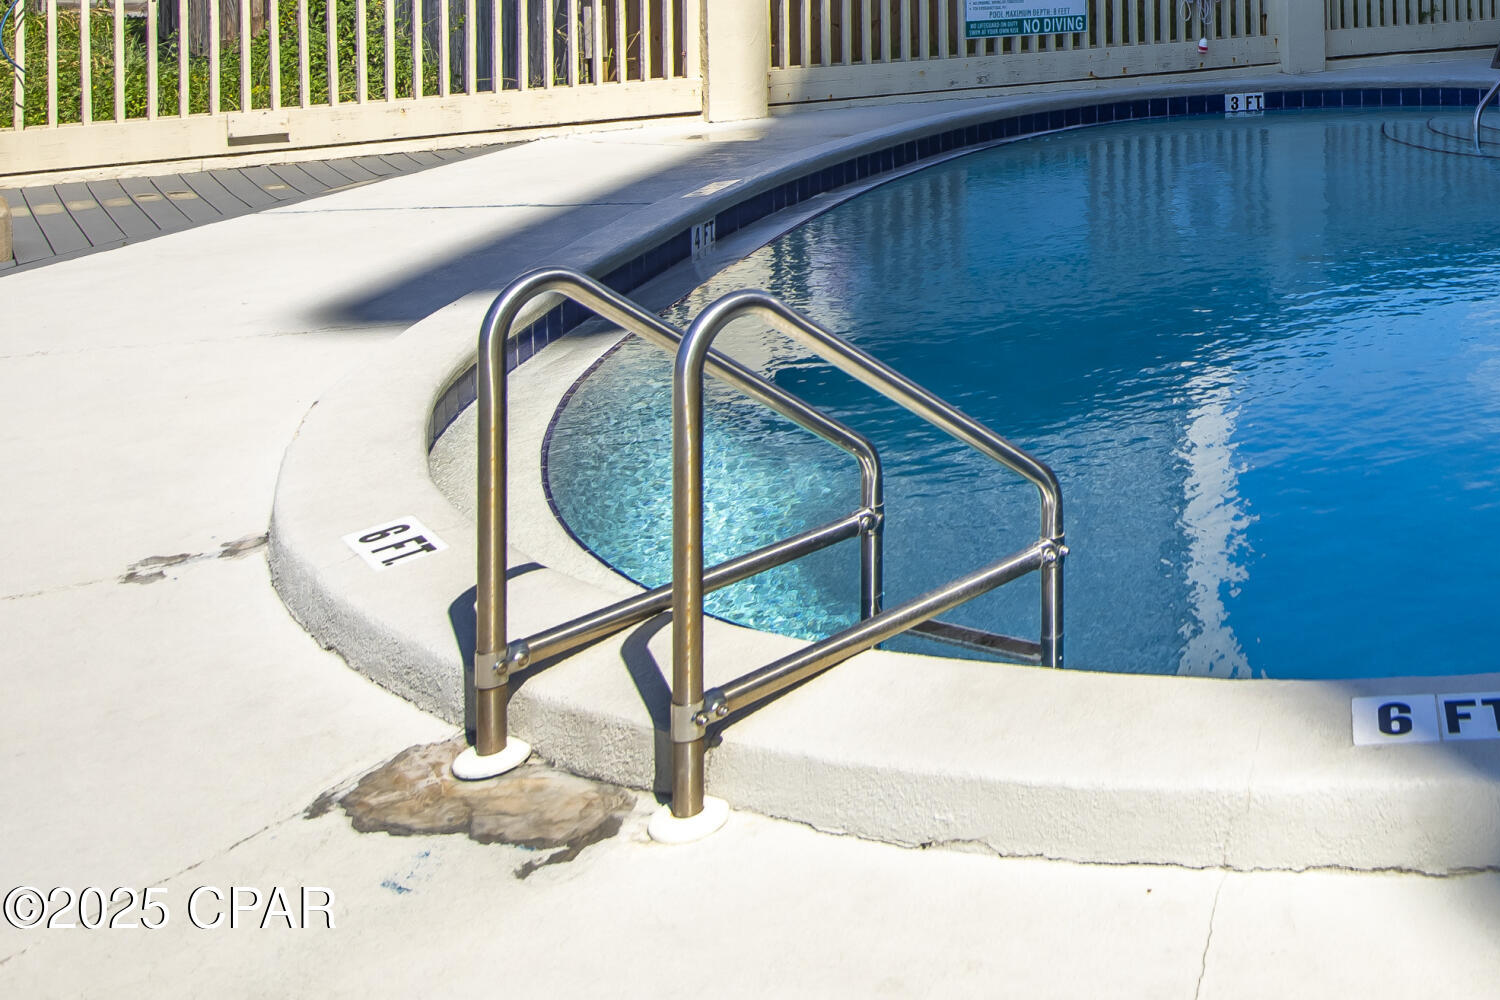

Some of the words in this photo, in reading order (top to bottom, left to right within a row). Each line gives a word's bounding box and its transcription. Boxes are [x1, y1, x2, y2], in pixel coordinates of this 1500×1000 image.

[989, 10, 1004, 18] POOL
[1005, 9, 1031, 18] MAXIMUM
[1032, 8, 1051, 16] DEPTH:
[1058, 7, 1070, 15] FEET
[1023, 19, 1040, 33] NO
[1043, 17, 1084, 32] DIVING
[1231, 96, 1239, 110] 3
[694, 226, 700, 249] 4
[358, 524, 410, 543] 6
[1377, 702, 1413, 735] 6
